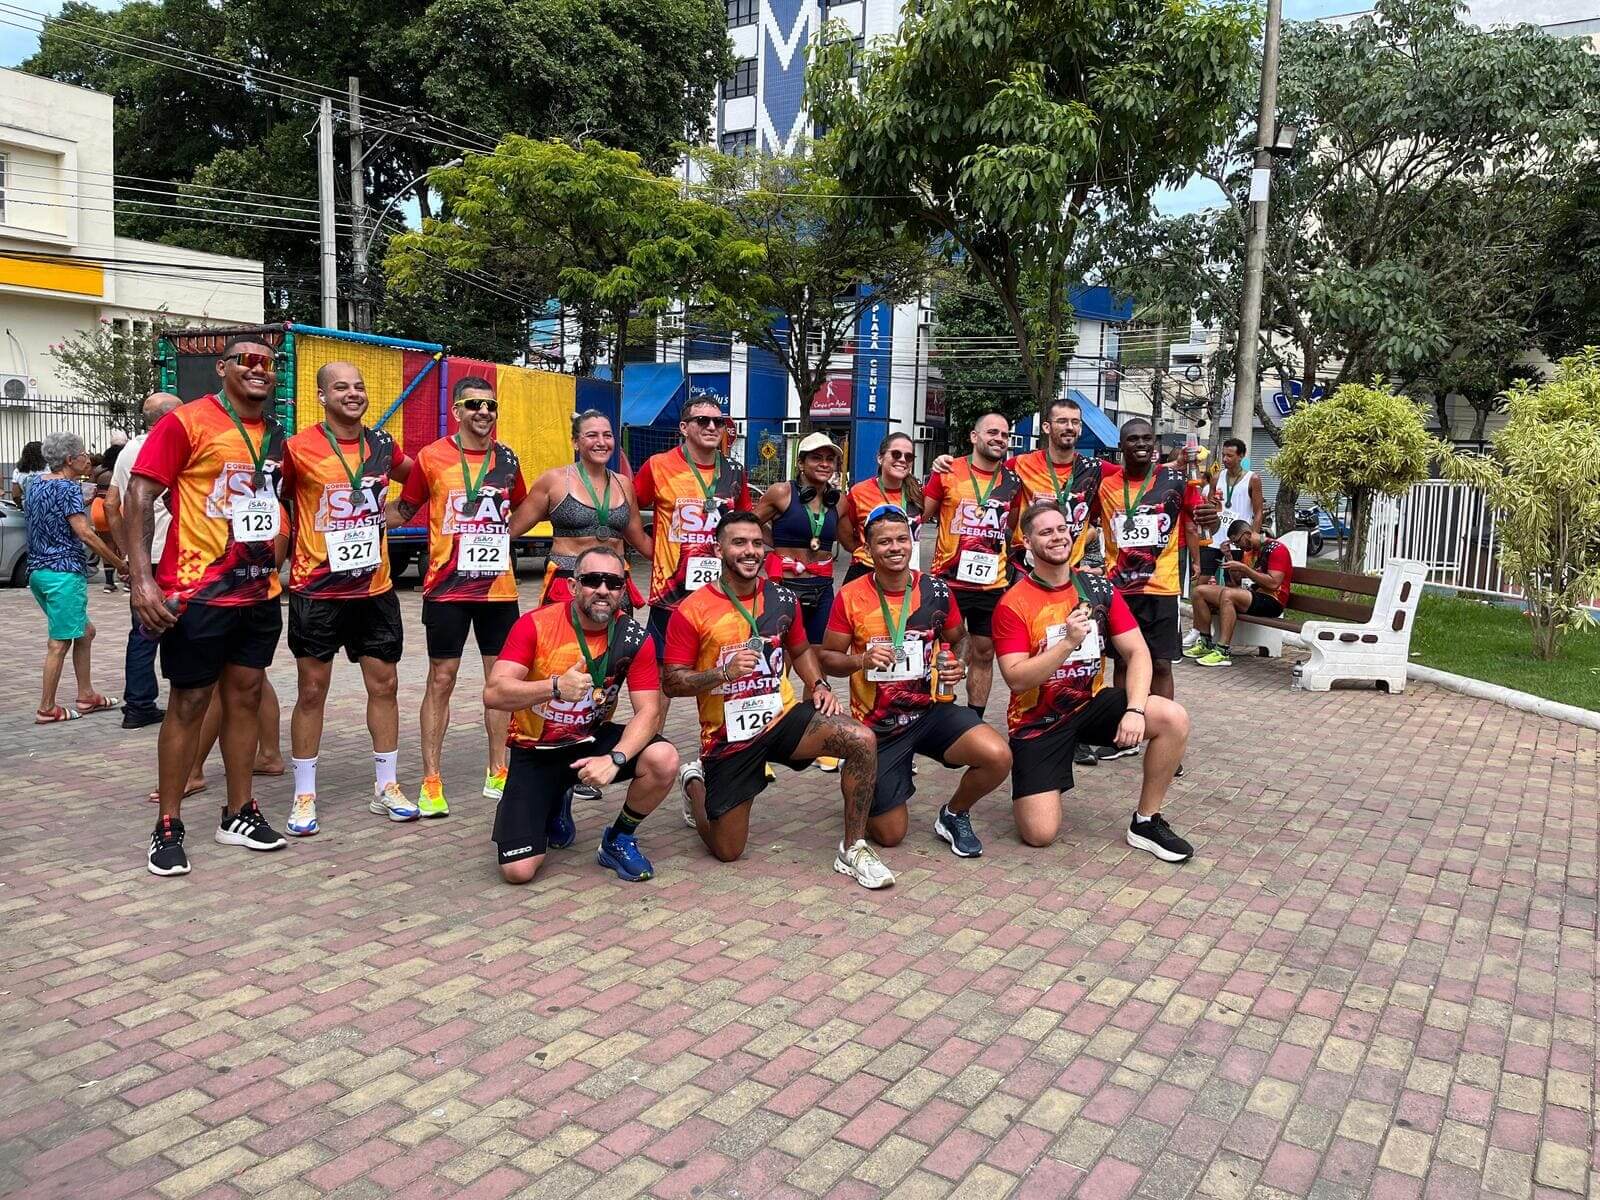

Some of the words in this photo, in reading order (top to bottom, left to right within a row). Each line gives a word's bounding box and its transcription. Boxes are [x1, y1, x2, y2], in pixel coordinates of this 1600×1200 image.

[870, 304, 880, 350] PLAZA
[868, 359, 878, 412] CENTER
[242, 514, 273, 532] 123
[453, 523, 508, 534] SEBASTI
[1122, 527, 1150, 541] 339
[338, 542, 373, 561] 327
[466, 547, 500, 562] 122
[693, 570, 720, 583] 281
[966, 563, 991, 577] 157
[736, 711, 773, 731] 126
